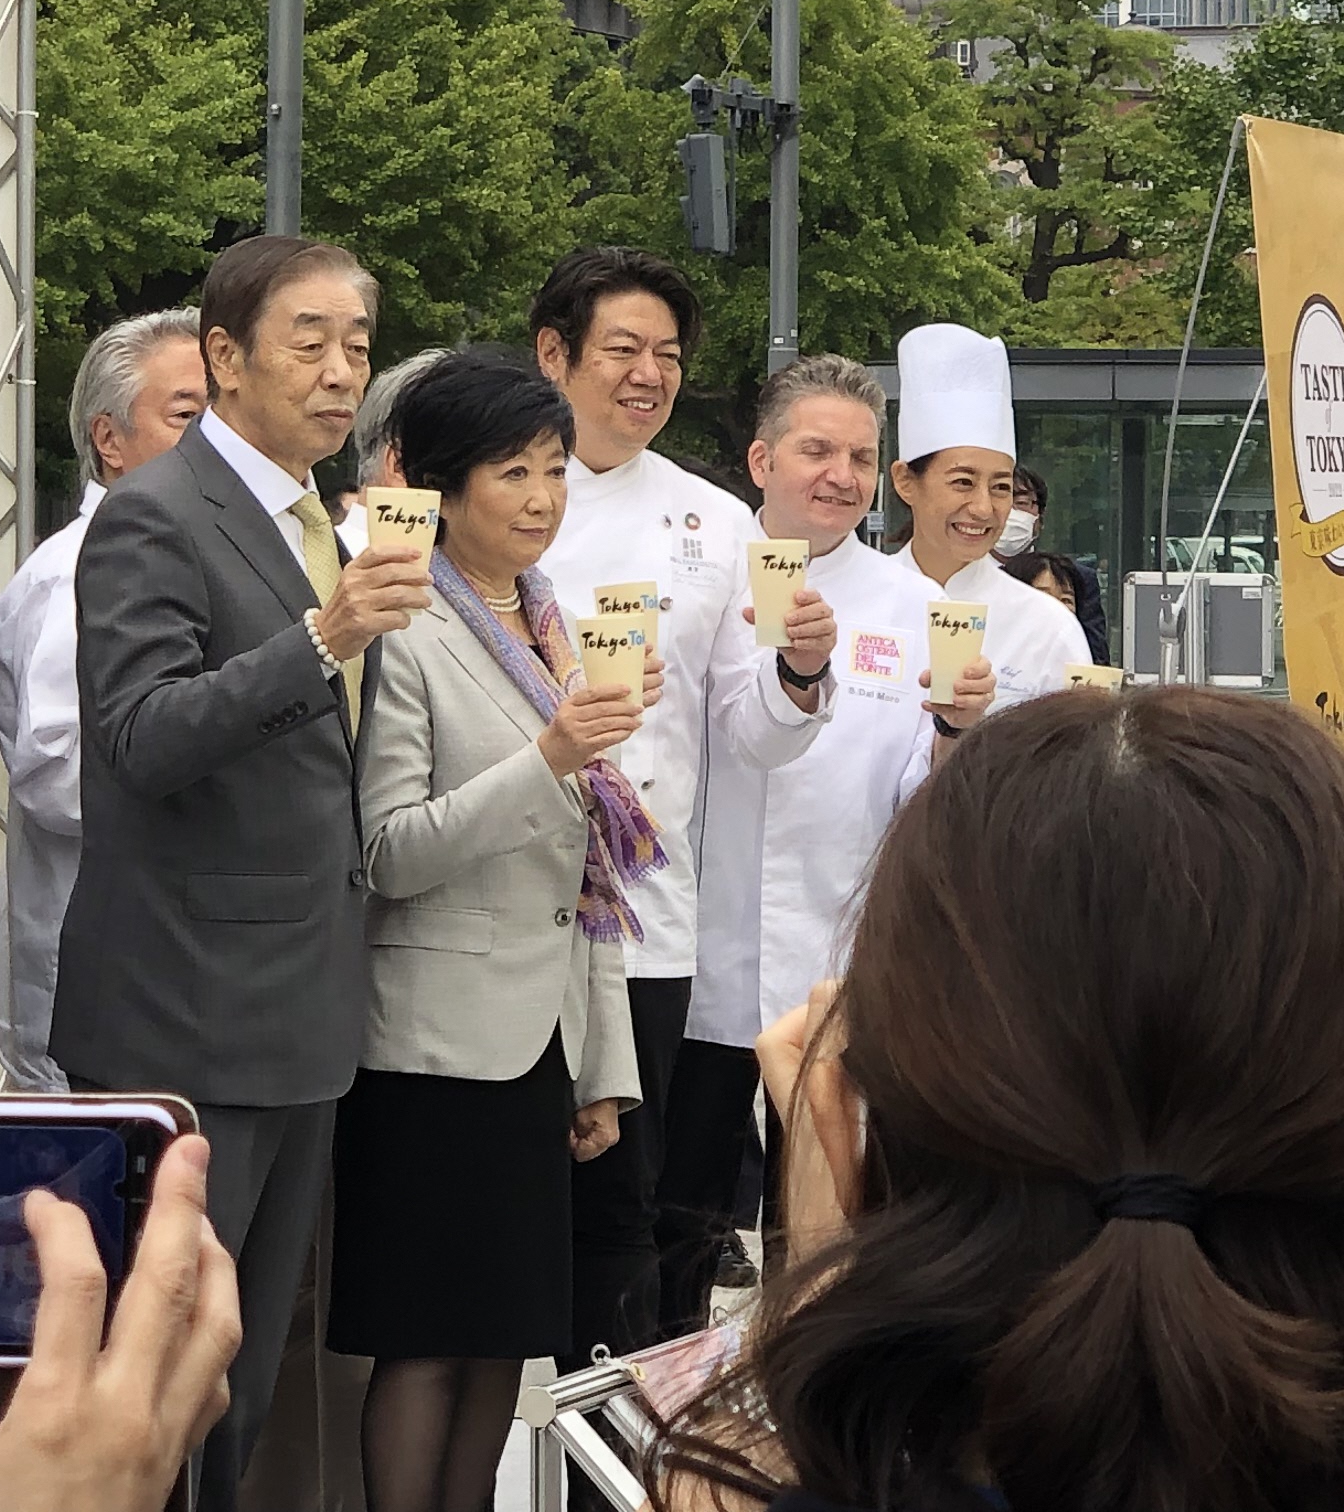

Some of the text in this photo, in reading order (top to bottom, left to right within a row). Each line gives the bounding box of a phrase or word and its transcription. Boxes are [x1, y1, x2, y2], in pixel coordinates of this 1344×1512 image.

[376, 505, 426, 534] Tokyo
[761, 555, 803, 578] Tokyo
[599, 597, 640, 614] Tokyo
[930, 612, 969, 636] Tokyo
[582, 632, 628, 657] Tokyo
[858, 634, 897, 648] ANTICA
